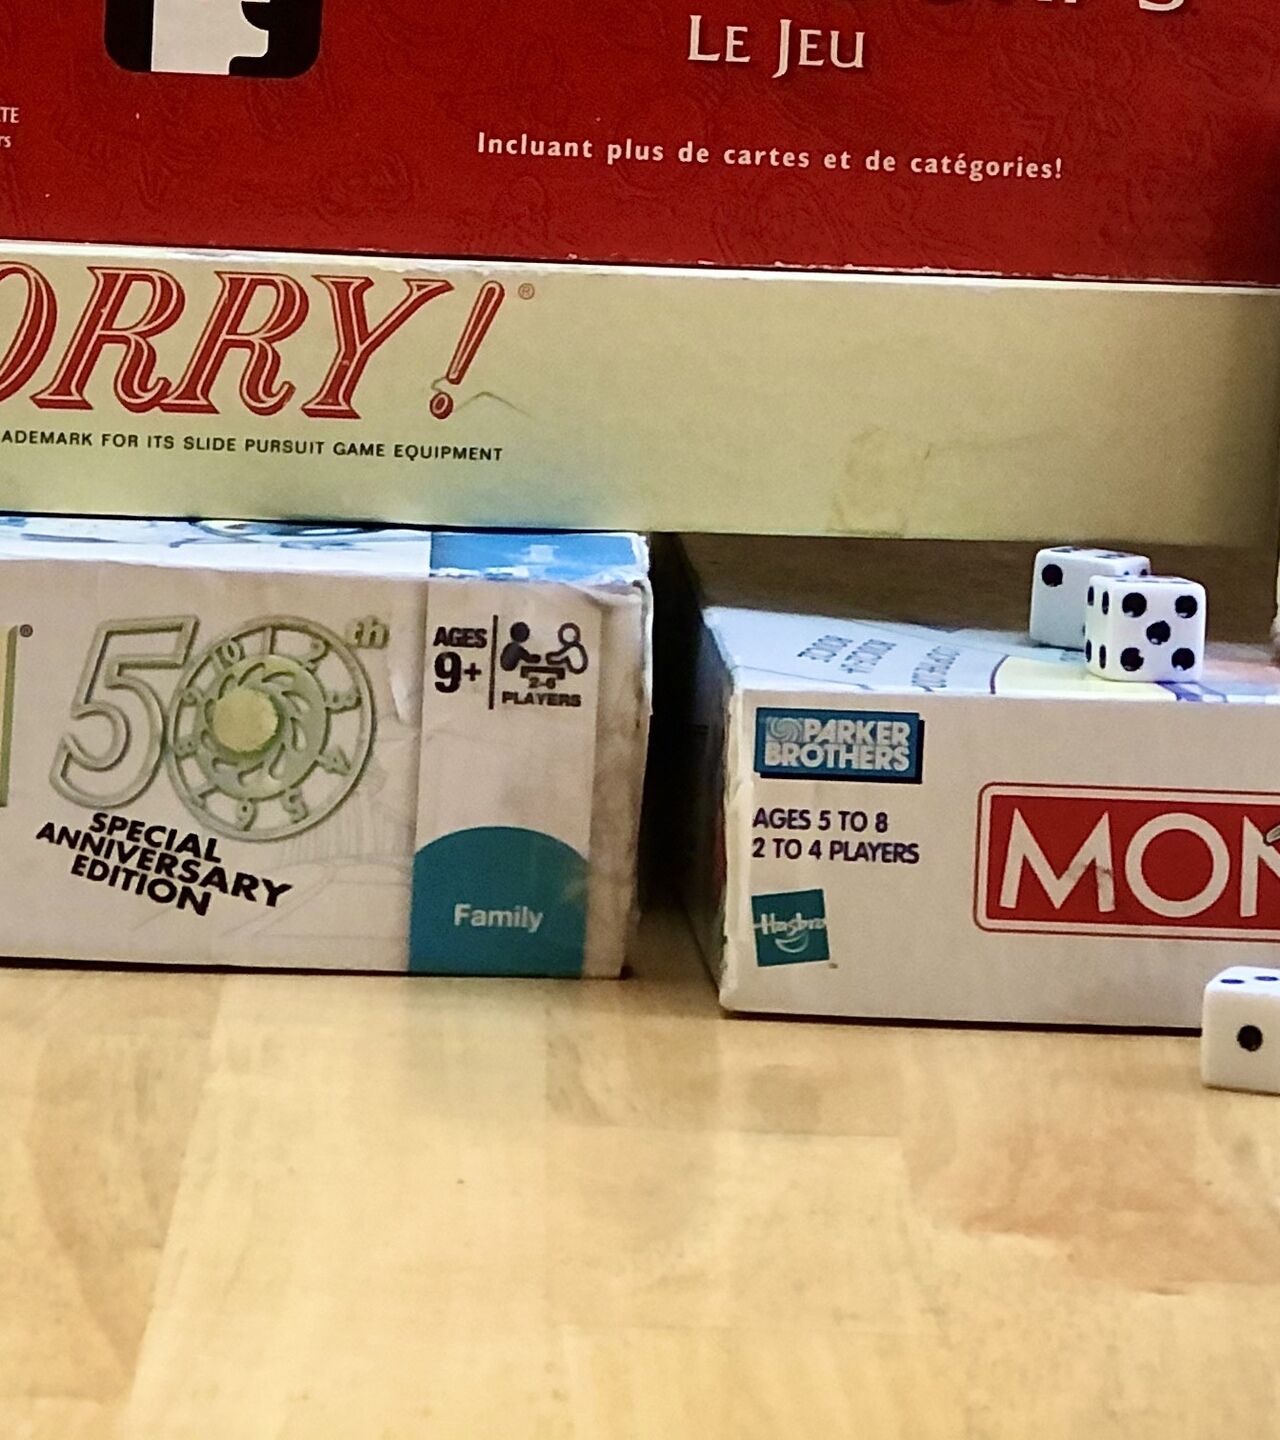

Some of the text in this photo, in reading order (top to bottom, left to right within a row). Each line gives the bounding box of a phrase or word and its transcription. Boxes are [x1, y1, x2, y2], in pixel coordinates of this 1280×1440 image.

[478, 132, 1063, 182] Incluant plus de cartes et de catégories!
[101, 433, 138, 448] FOR
[147, 435, 174, 449] ITS
[183, 436, 236, 451] SLIDE
[245, 439, 325, 455] PURSUIT
[333, 442, 385, 457] GAME
[394, 444, 503, 461] EQUIPMENT
[433, 626, 487, 648] AGES
[434, 651, 482, 693] 9+
[502, 691, 581, 707] PLAYERS
[804, 719, 911, 746] PARKER
[765, 742, 910, 771] BROTHERS
[752, 808, 888, 833] AGES 5 TO 8
[89, 812, 221, 863] SPECIAL
[752, 837, 920, 865] 2 TO 4 PLAYERS
[36, 822, 293, 907] ANNIVERSARY
[71, 855, 211, 916] EDITION
[453, 902, 543, 933] Family
